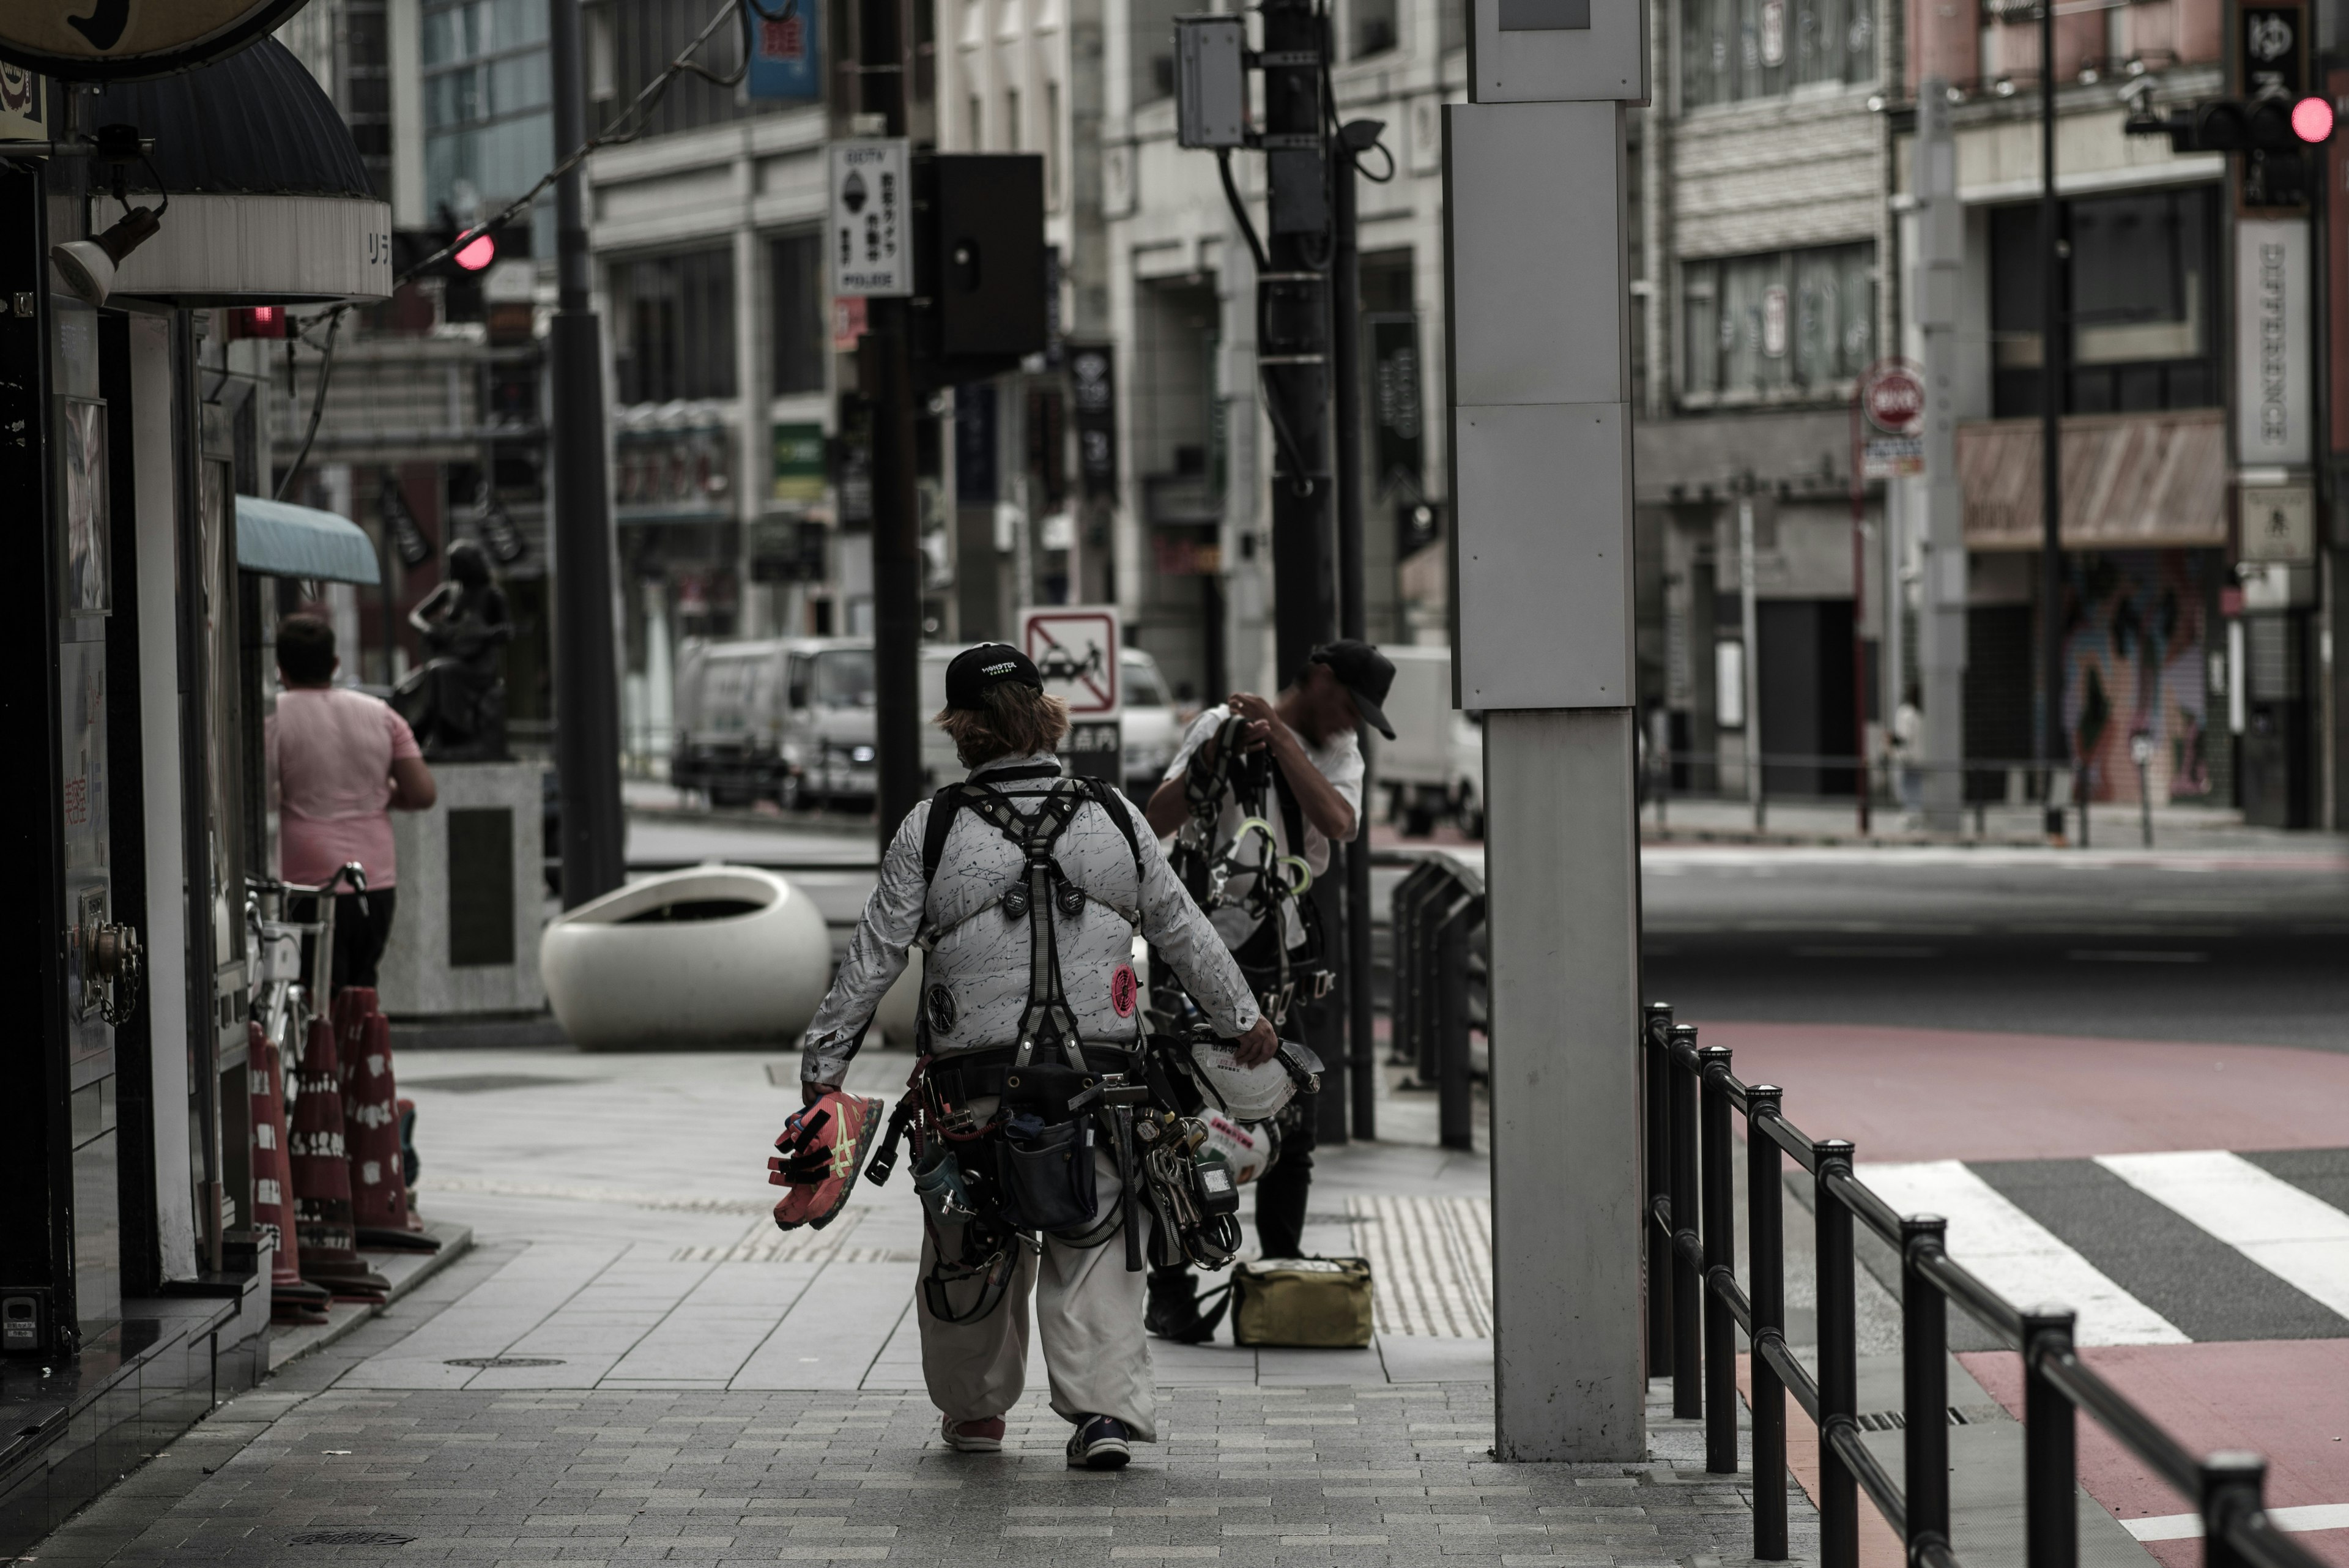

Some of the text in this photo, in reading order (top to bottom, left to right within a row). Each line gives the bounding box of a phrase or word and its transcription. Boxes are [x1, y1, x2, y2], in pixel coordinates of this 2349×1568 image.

[982, 662, 1017, 673] MONSTER
[65, 775, 87, 826] 美容室
